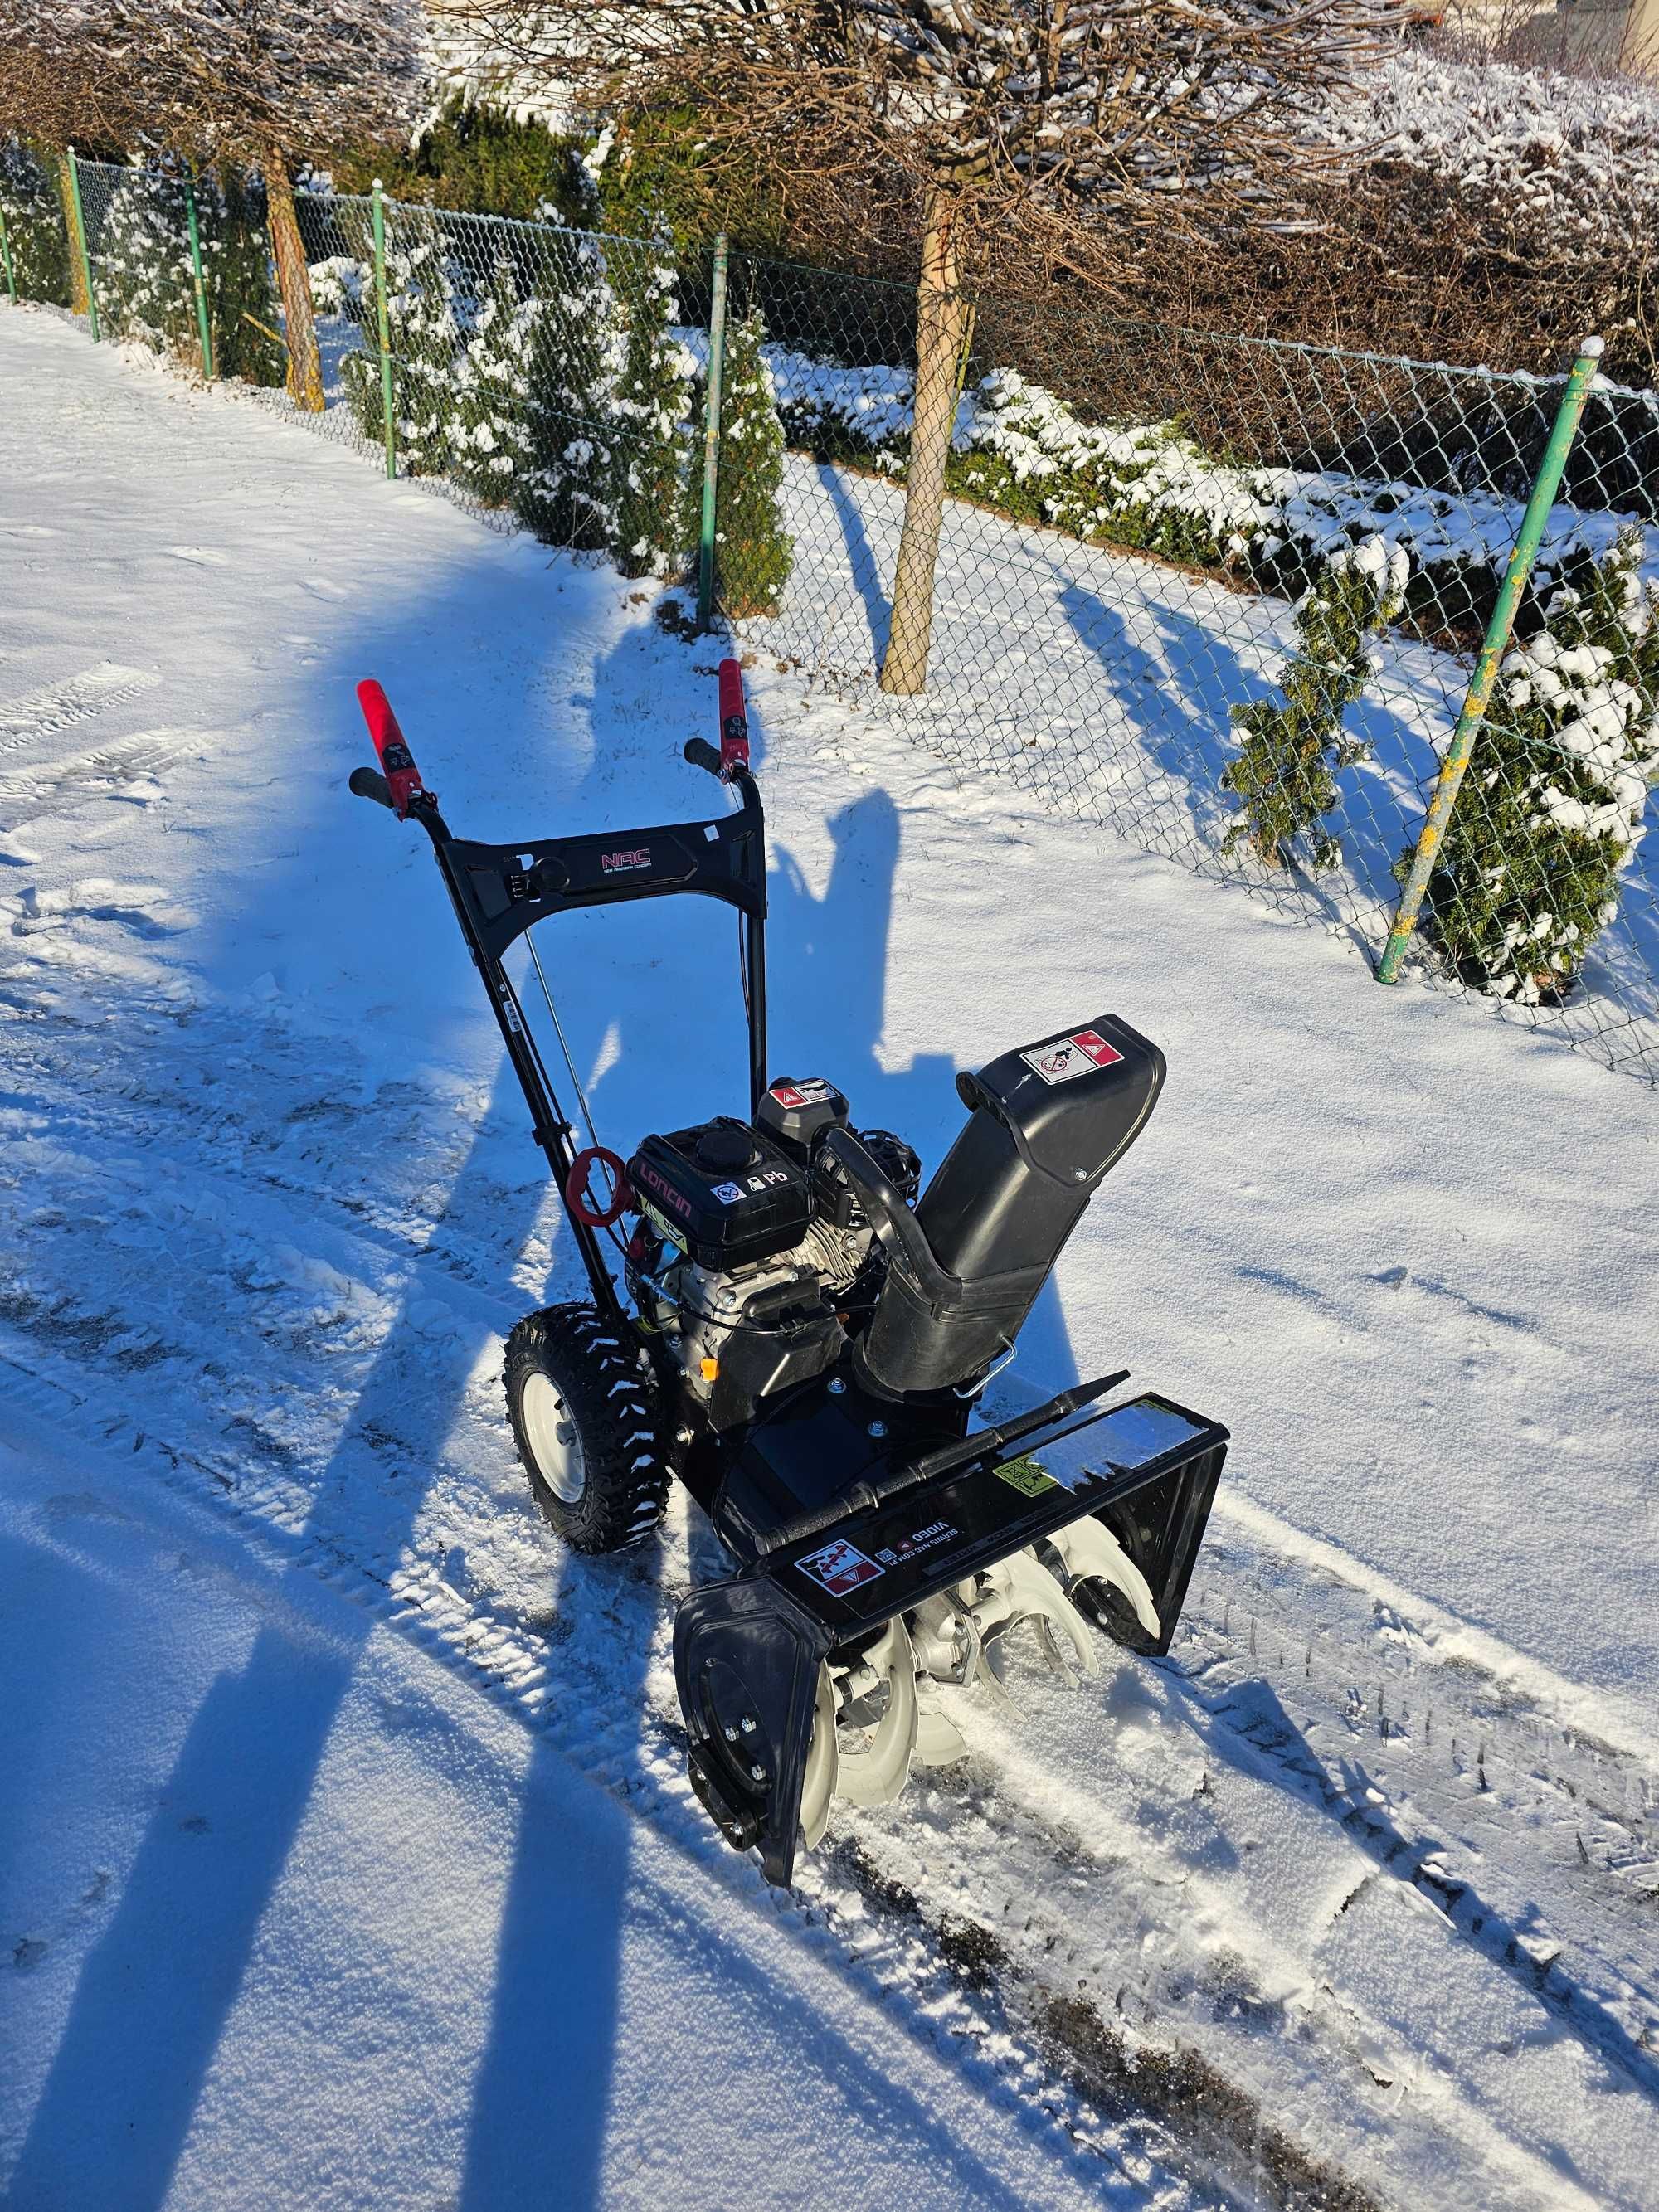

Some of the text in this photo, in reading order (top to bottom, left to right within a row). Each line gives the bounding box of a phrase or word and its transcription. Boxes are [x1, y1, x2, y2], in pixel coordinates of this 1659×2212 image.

[601, 848, 650, 869] NAC
[763, 1170, 788, 1185] Pb
[640, 1163, 692, 1218] LONCIN
[912, 1521, 950, 1542] VIDEO
[885, 1529, 959, 1568] SERWIS.NAC.COM.PL
